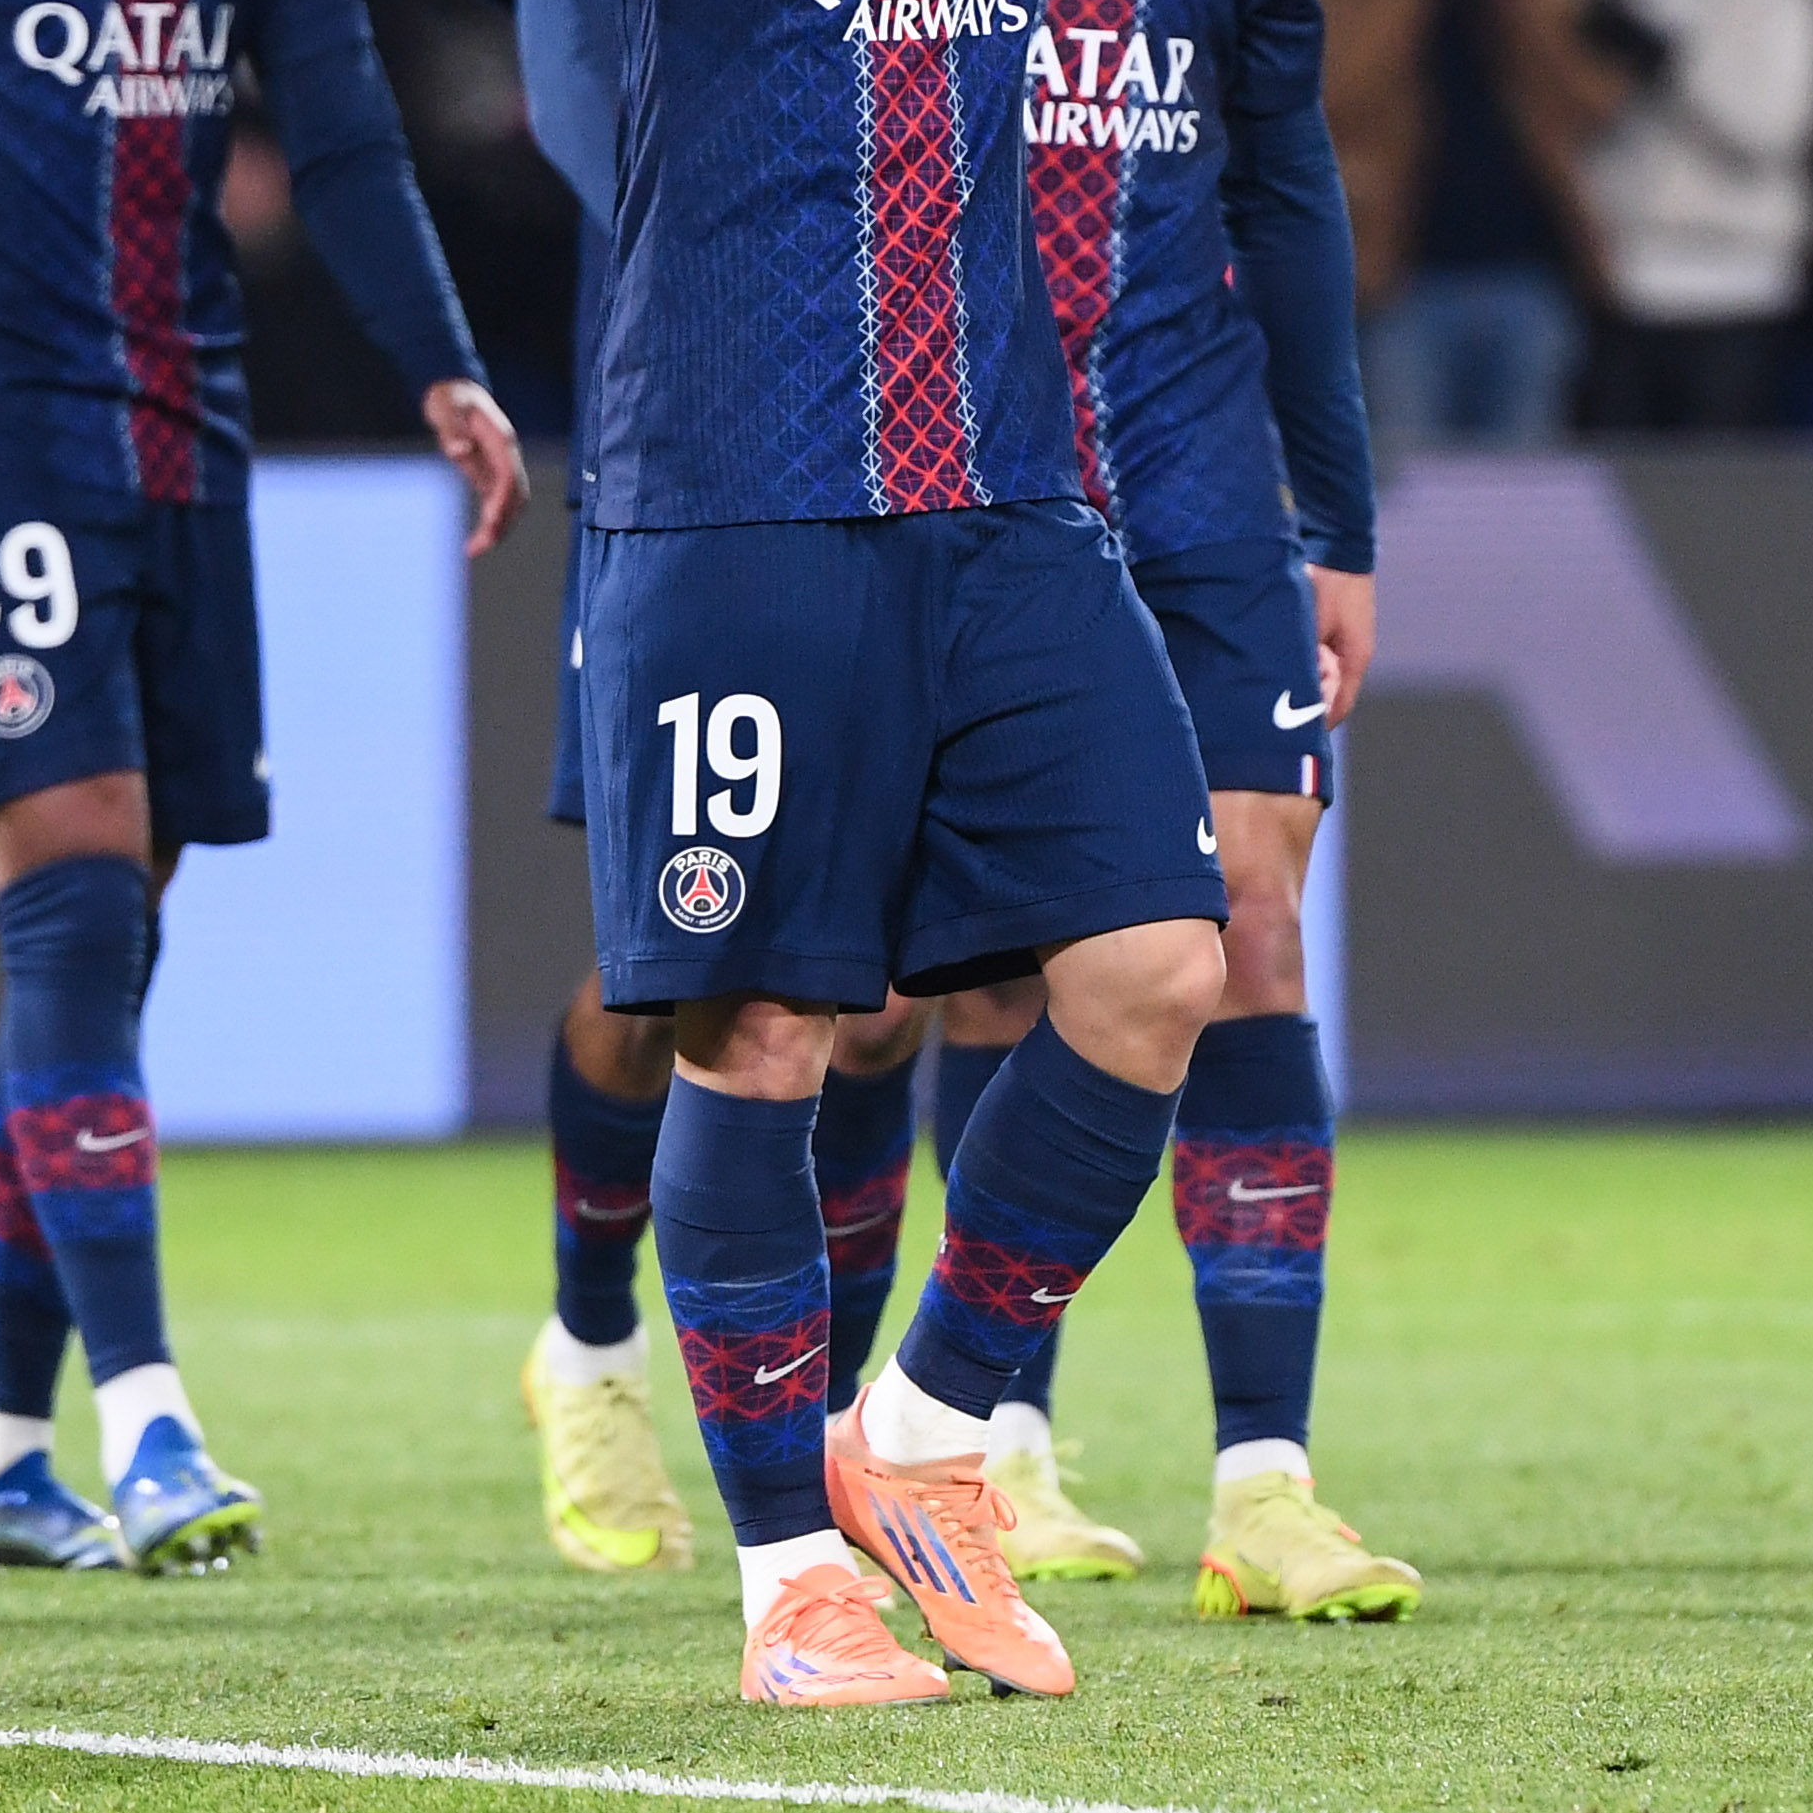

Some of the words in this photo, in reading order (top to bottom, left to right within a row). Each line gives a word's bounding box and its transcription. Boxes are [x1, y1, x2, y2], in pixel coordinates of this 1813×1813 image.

[1025, 24, 1197, 105] ATAR
[657, 691, 782, 839] 19
[674, 851, 731, 873] PARIS
